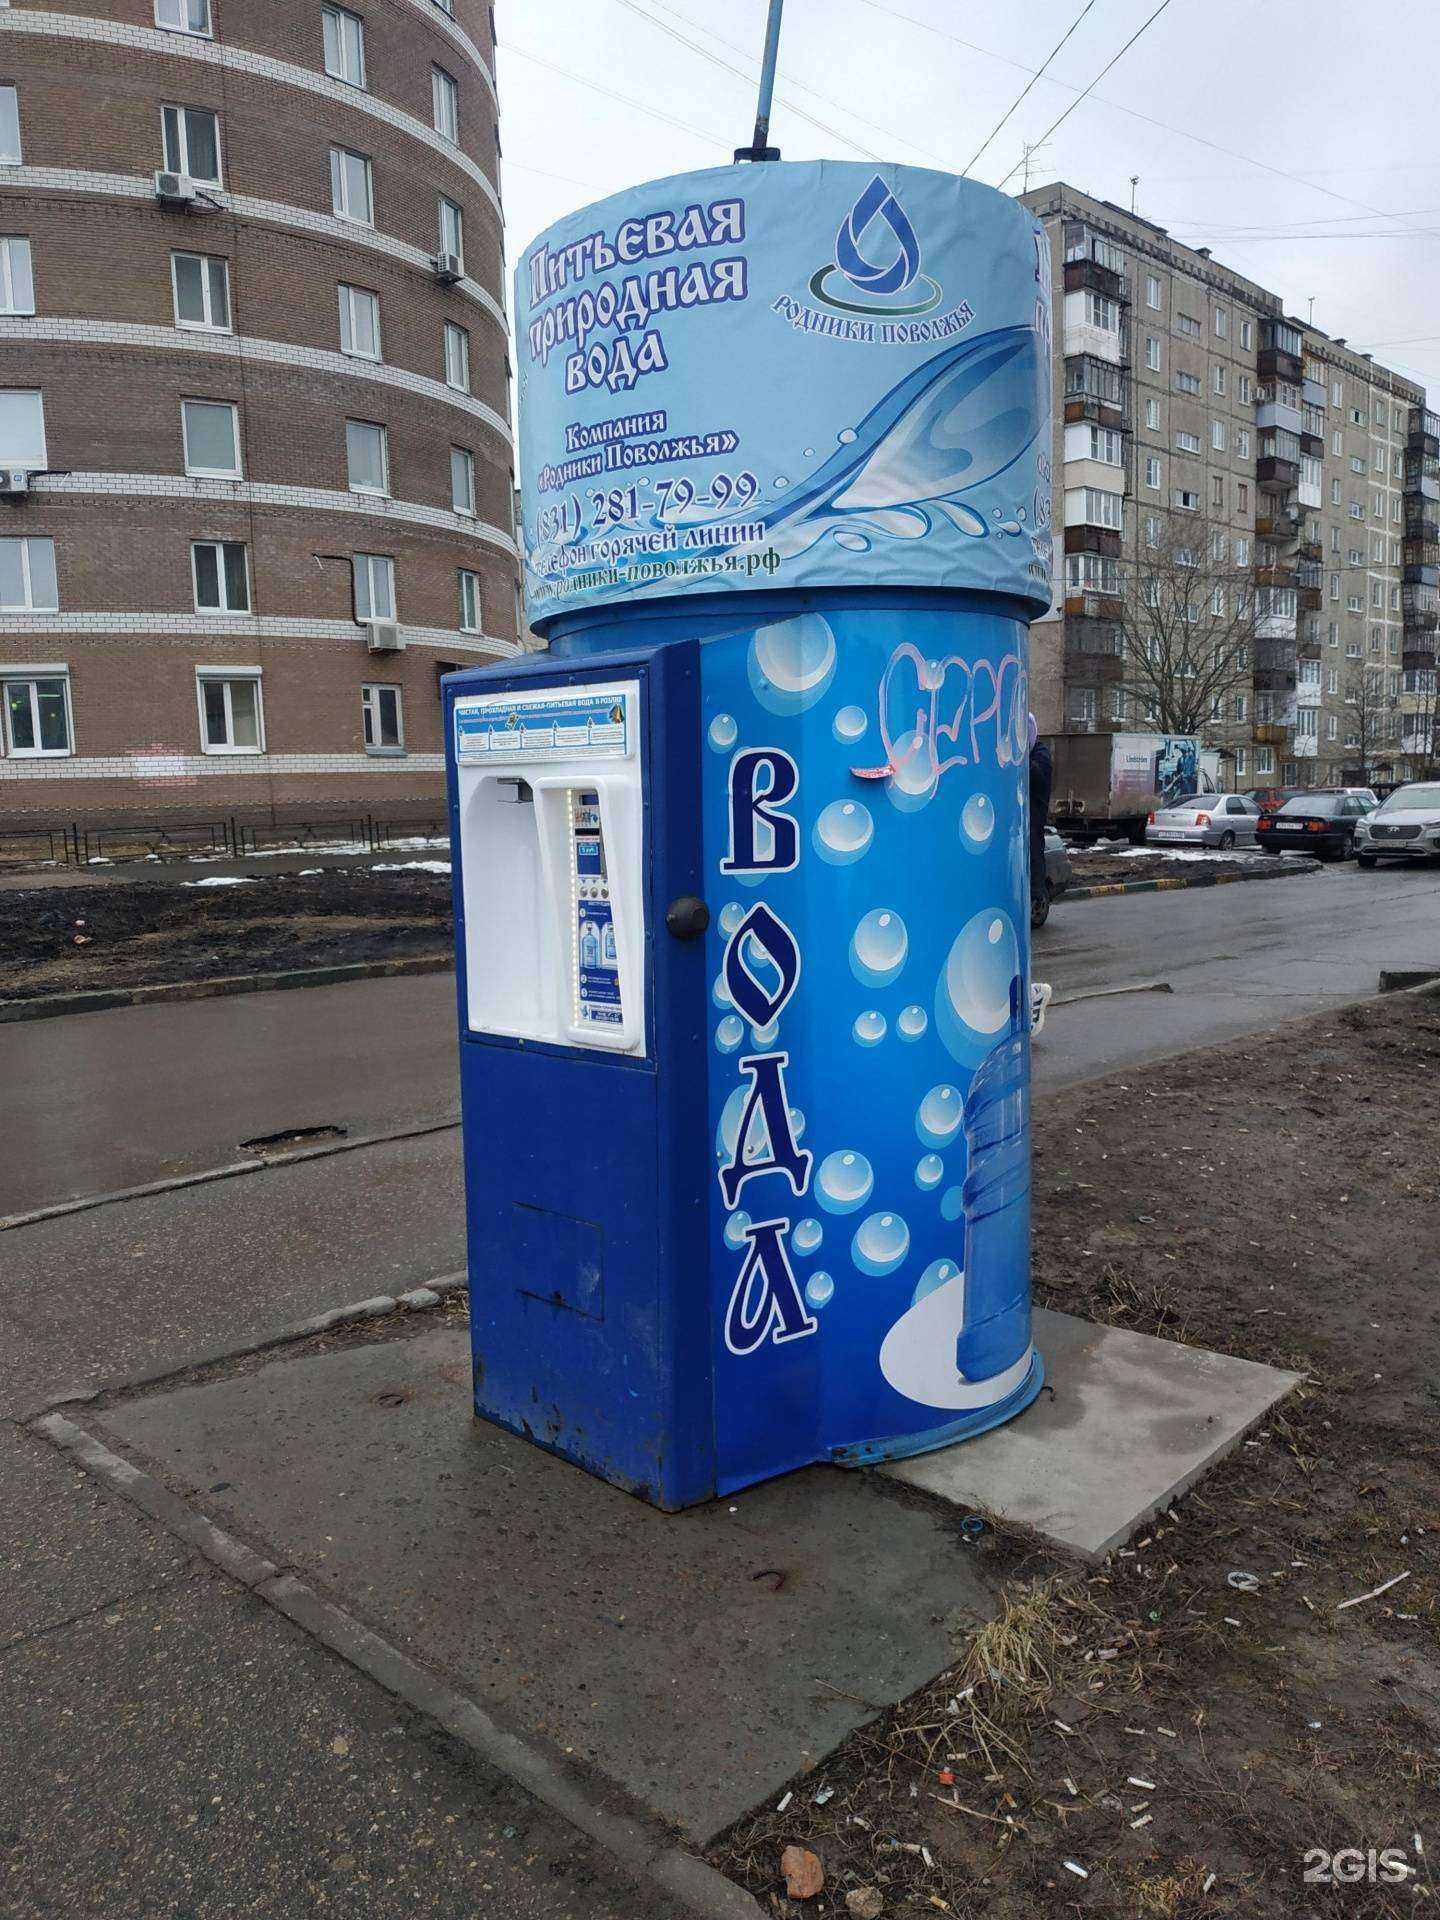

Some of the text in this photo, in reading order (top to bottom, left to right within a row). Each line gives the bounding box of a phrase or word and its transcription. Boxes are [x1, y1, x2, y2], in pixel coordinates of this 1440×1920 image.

[529, 198, 745, 311] Питьевая
[529, 256, 748, 367] природная
[771, 294, 976, 344] РОДНИКИ ПОВОЛЖЬЯ
[565, 329, 668, 394] вода
[565, 410, 667, 453] Компания
[604, 430, 741, 472] Поволжья»
[591, 471, 758, 527] 281-79-99
[590, 525, 678, 566] горячей
[685, 522, 765, 547] линии
[717, 746, 819, 1356] ВОДА
